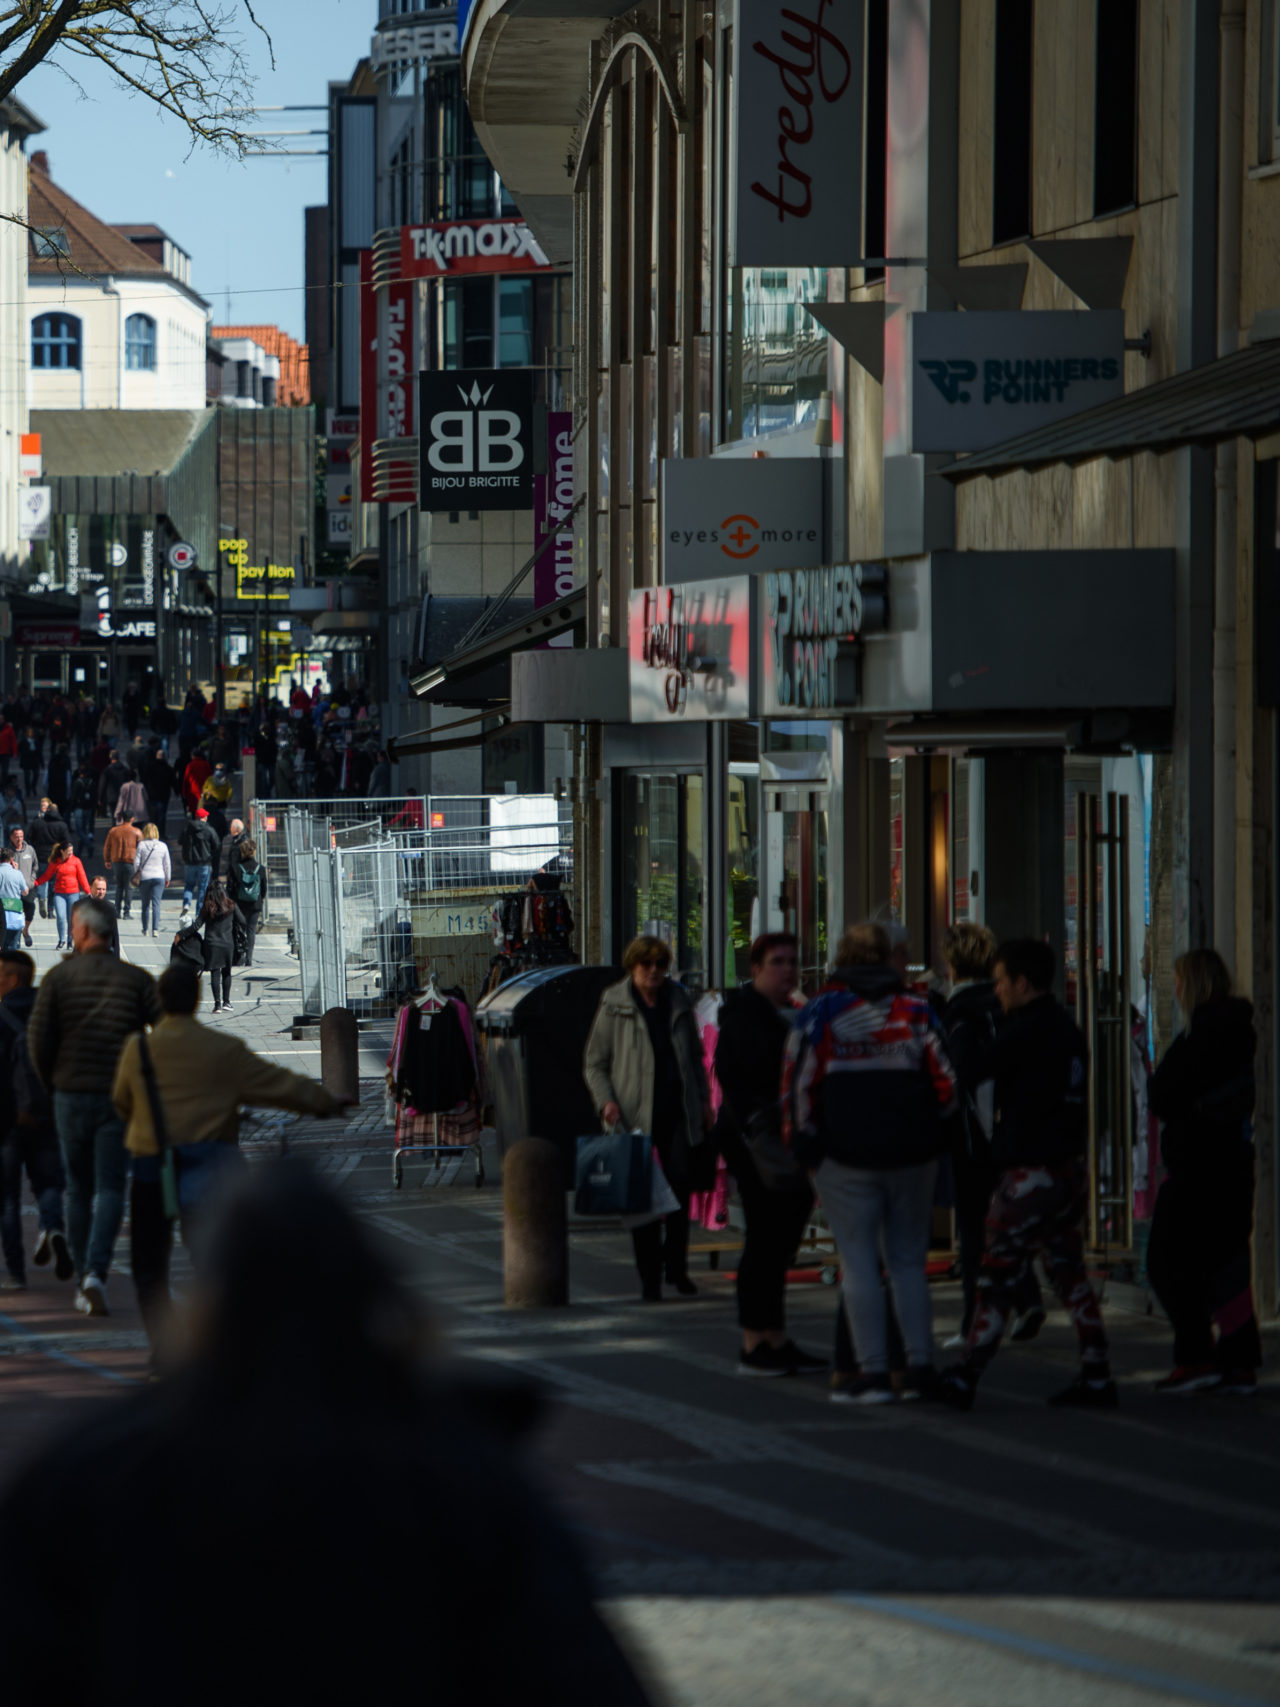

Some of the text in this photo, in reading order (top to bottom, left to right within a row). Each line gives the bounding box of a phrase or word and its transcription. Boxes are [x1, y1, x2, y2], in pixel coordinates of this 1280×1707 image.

[751, 0, 851, 223] tredy
[984, 358, 1119, 381] RUNNERS
[984, 381, 1069, 404] POINT
[431, 476, 520, 490] BIJOU BRIGITTE
[219, 539, 248, 552] pop
[670, 530, 719, 547] eyes
[762, 529, 817, 542] more
[239, 564, 295, 578] pavlion
